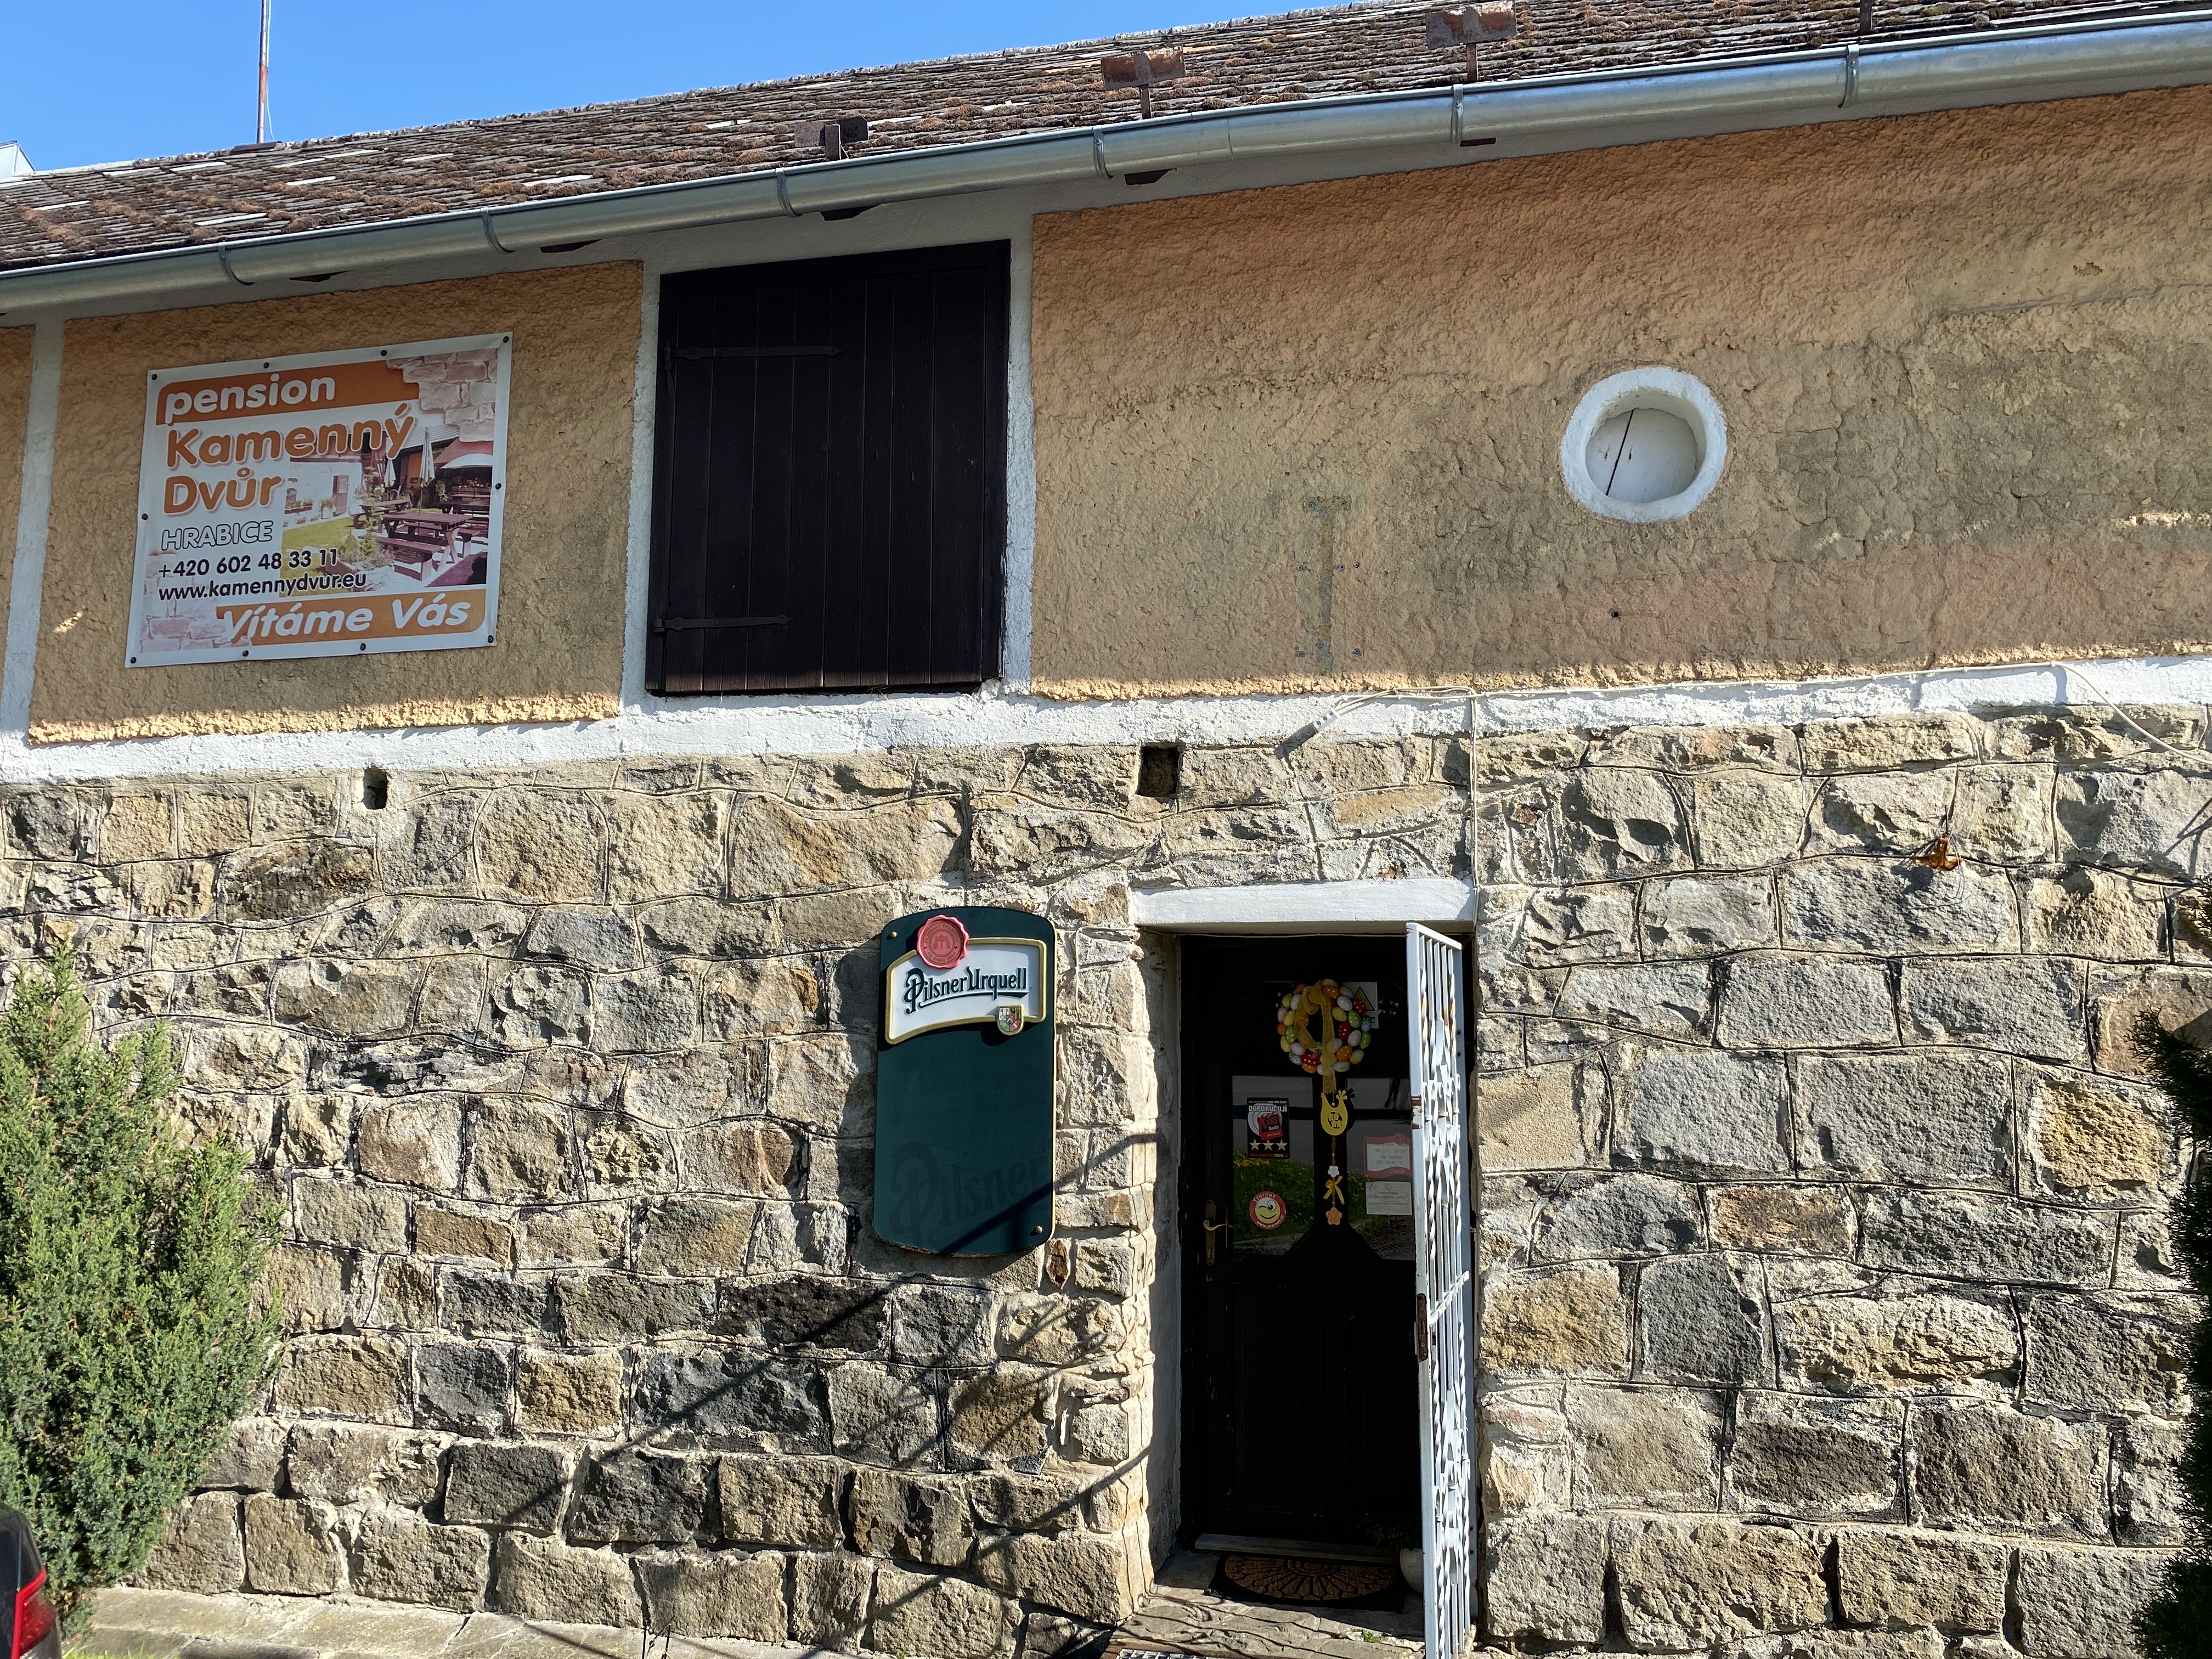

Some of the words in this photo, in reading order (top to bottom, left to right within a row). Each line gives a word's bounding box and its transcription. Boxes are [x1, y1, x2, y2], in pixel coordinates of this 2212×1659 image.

[165, 374, 335, 425] pension
[167, 403, 415, 467] Kamenný
[164, 467, 282, 514] Dvůr
[161, 520, 274, 551] HRABICE
[159, 558, 210, 577] +420
[216, 555, 251, 574] 602
[258, 552, 282, 570] 48
[289, 550, 312, 568] 33
[319, 548, 337, 566] 11
[159, 572, 366, 601] www.kamennydvur.eu
[222, 602, 373, 639] Vítáme
[392, 592, 471, 629] Vás
[904, 967, 967, 1014] Pilsner
[966, 966, 1027, 1000] Urquell
